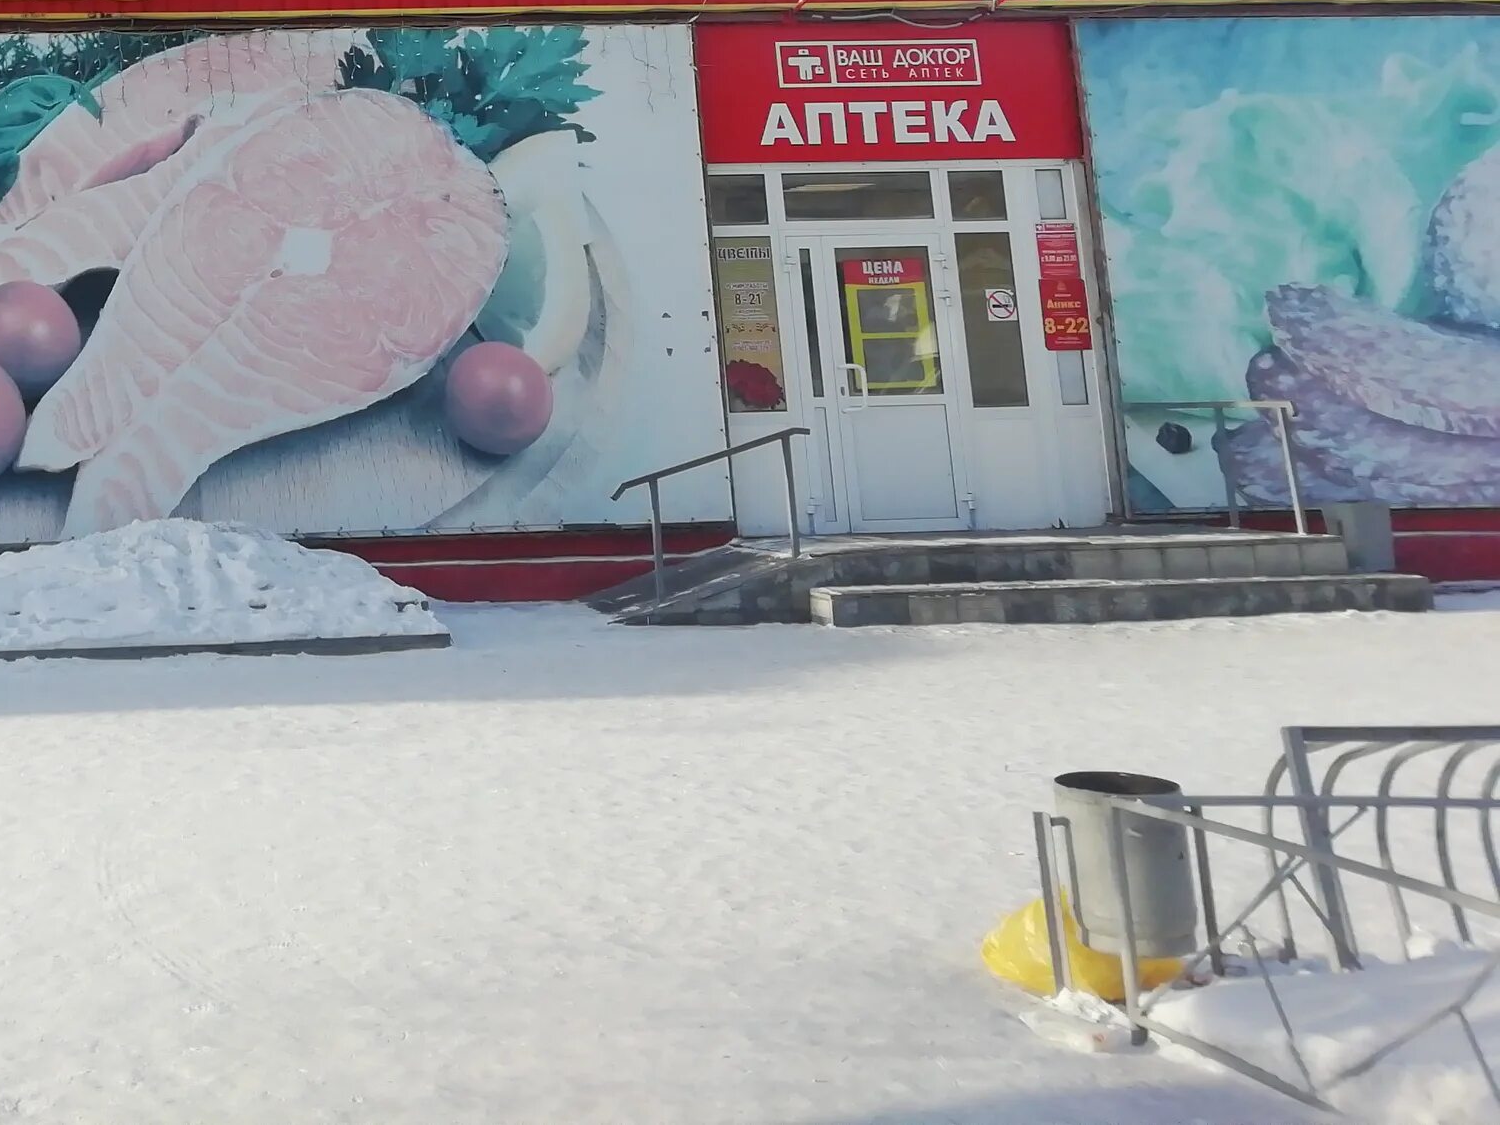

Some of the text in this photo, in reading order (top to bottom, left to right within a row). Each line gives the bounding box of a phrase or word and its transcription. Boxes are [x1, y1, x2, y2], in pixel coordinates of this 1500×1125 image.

[836, 48, 971, 68] ВАШ ДОКТОР
[846, 67, 964, 79] СЕТЬ АПТЕК
[760, 100, 1017, 146] АПТЕКА
[862, 260, 904, 276] ЦЕНА
[734, 293, 762, 306] 8-21
[1044, 317, 1089, 334] 8-22
